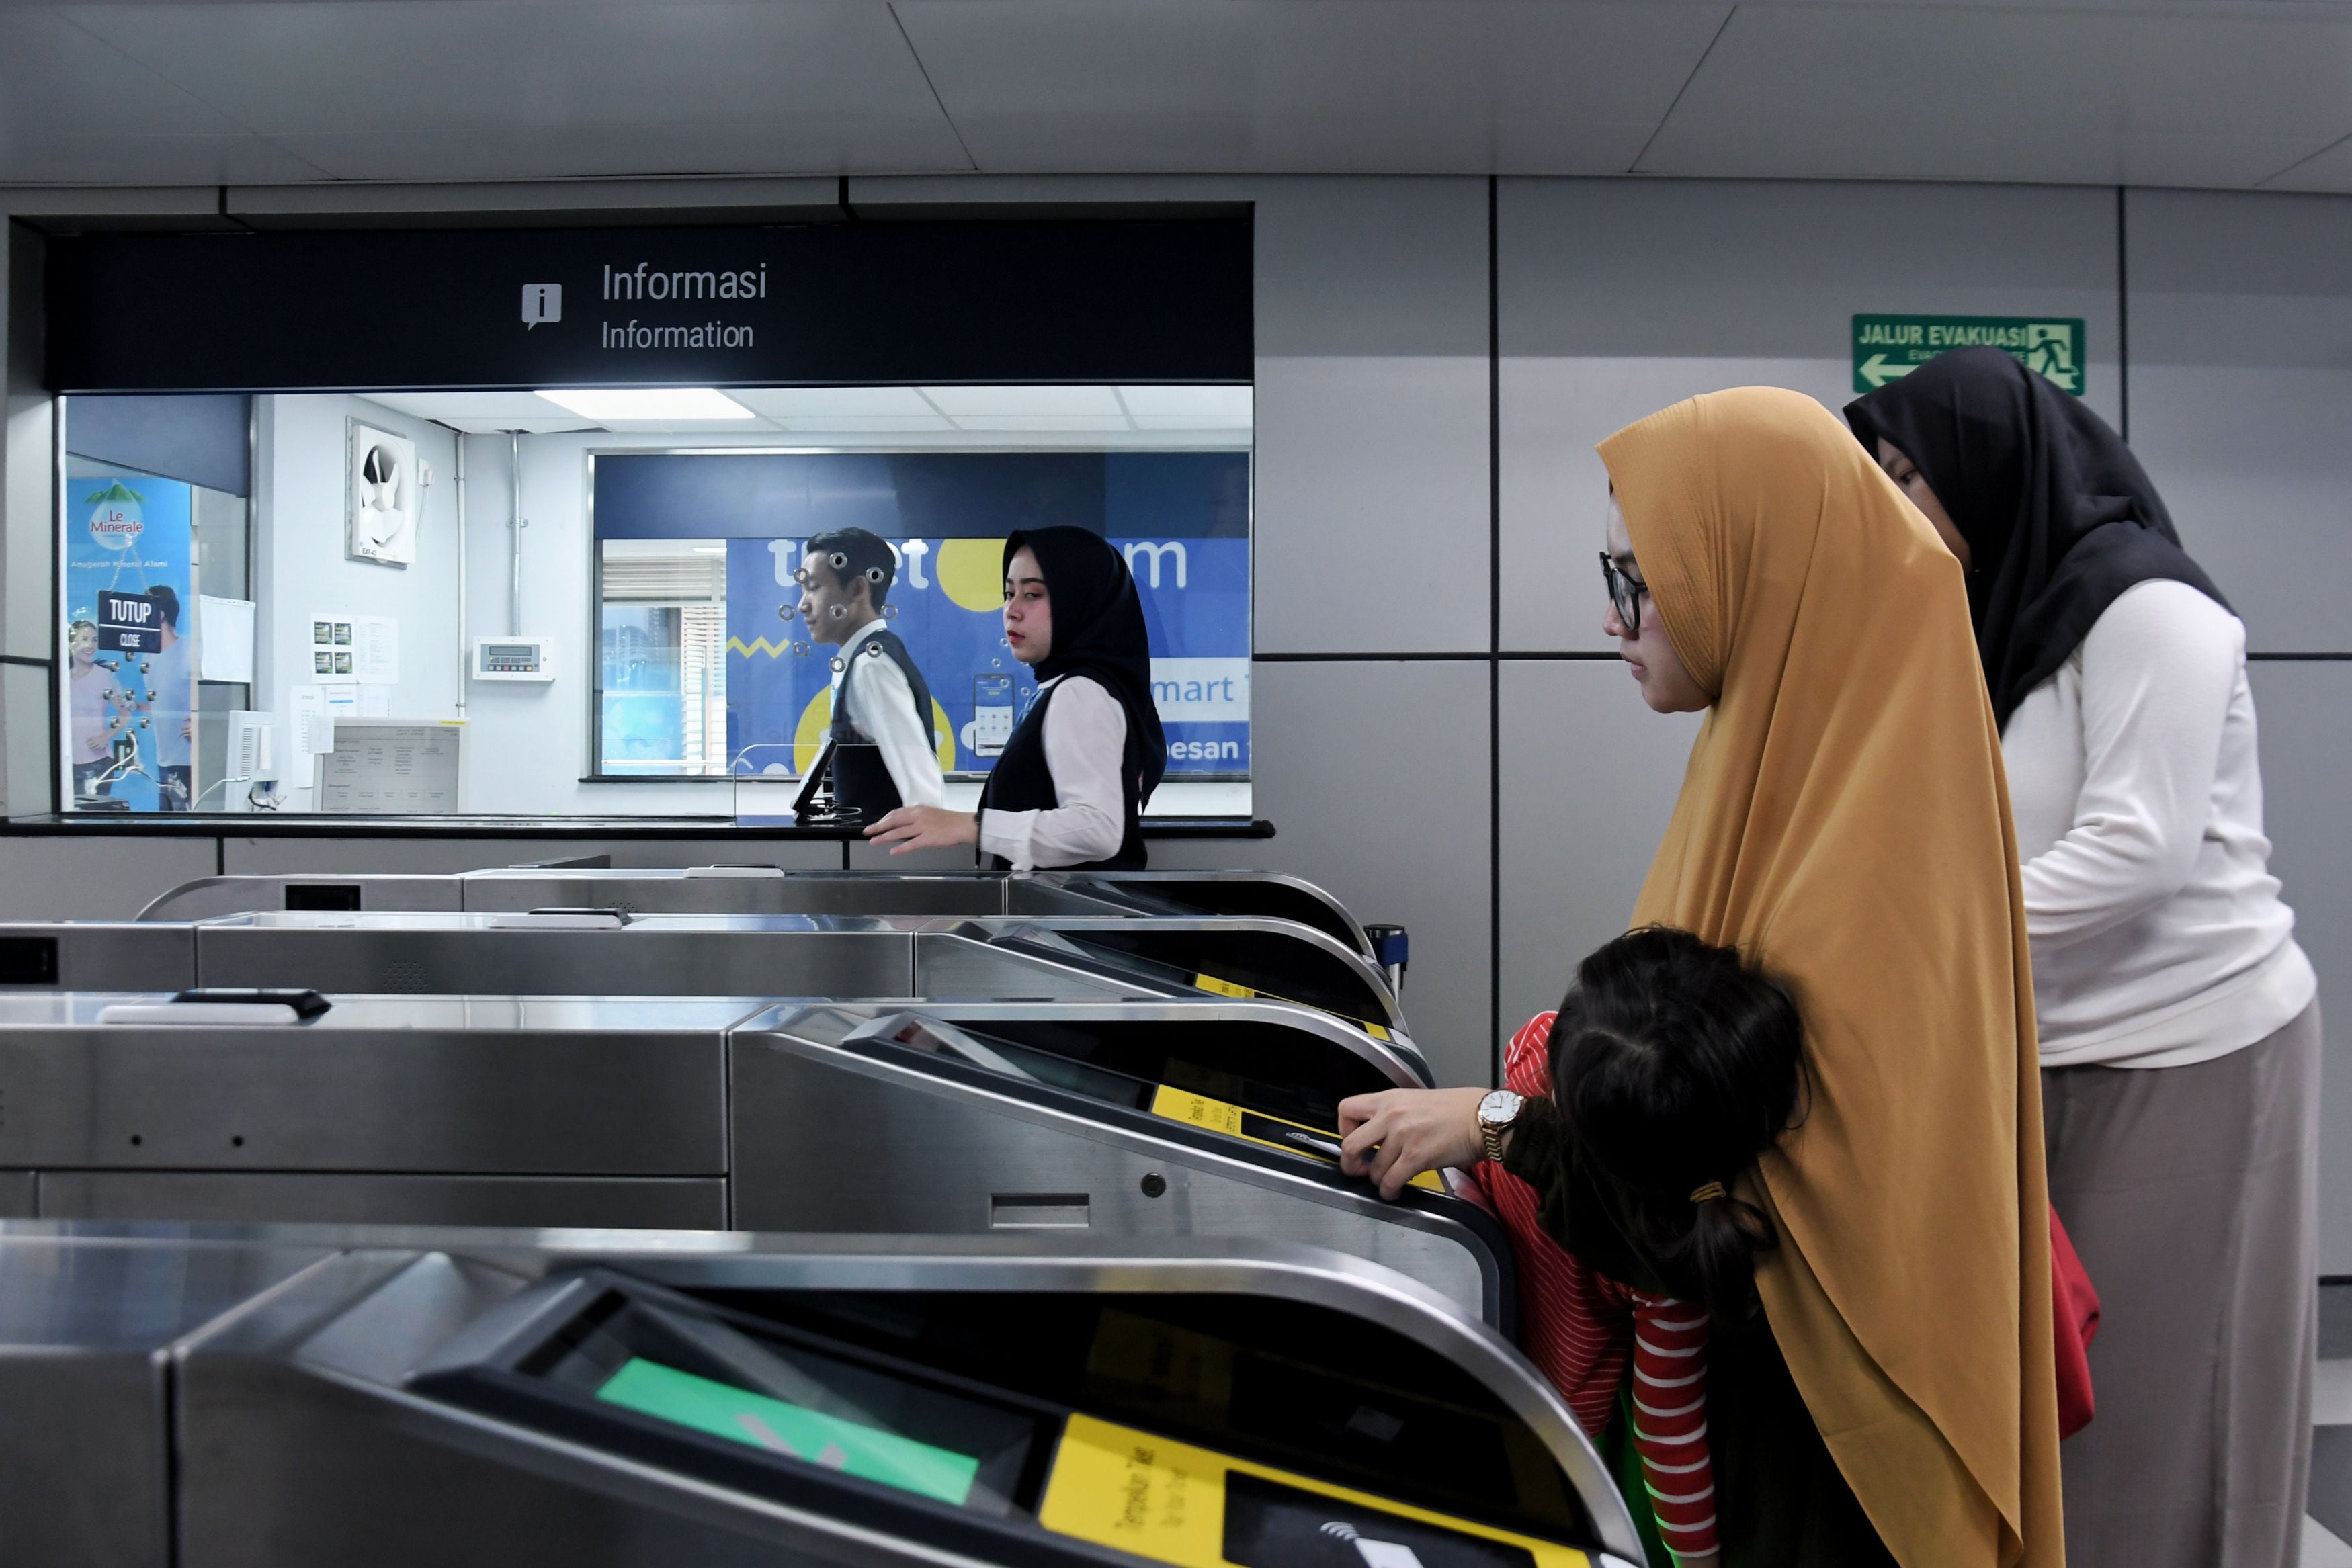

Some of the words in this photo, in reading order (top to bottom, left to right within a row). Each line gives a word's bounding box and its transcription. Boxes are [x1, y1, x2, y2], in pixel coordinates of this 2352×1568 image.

[602, 262, 767, 300] Informasi
[601, 319, 754, 349] Information
[1859, 324, 1924, 345] JALUR
[1929, 325, 2027, 347] EVAKUASI
[90, 521, 143, 533] Minerale
[109, 509, 124, 522] Le
[109, 599, 152, 623] TUTUP
[120, 633, 141, 648] CLOSE
[1152, 676, 1234, 702] mart
[1167, 741, 1239, 760] esan
